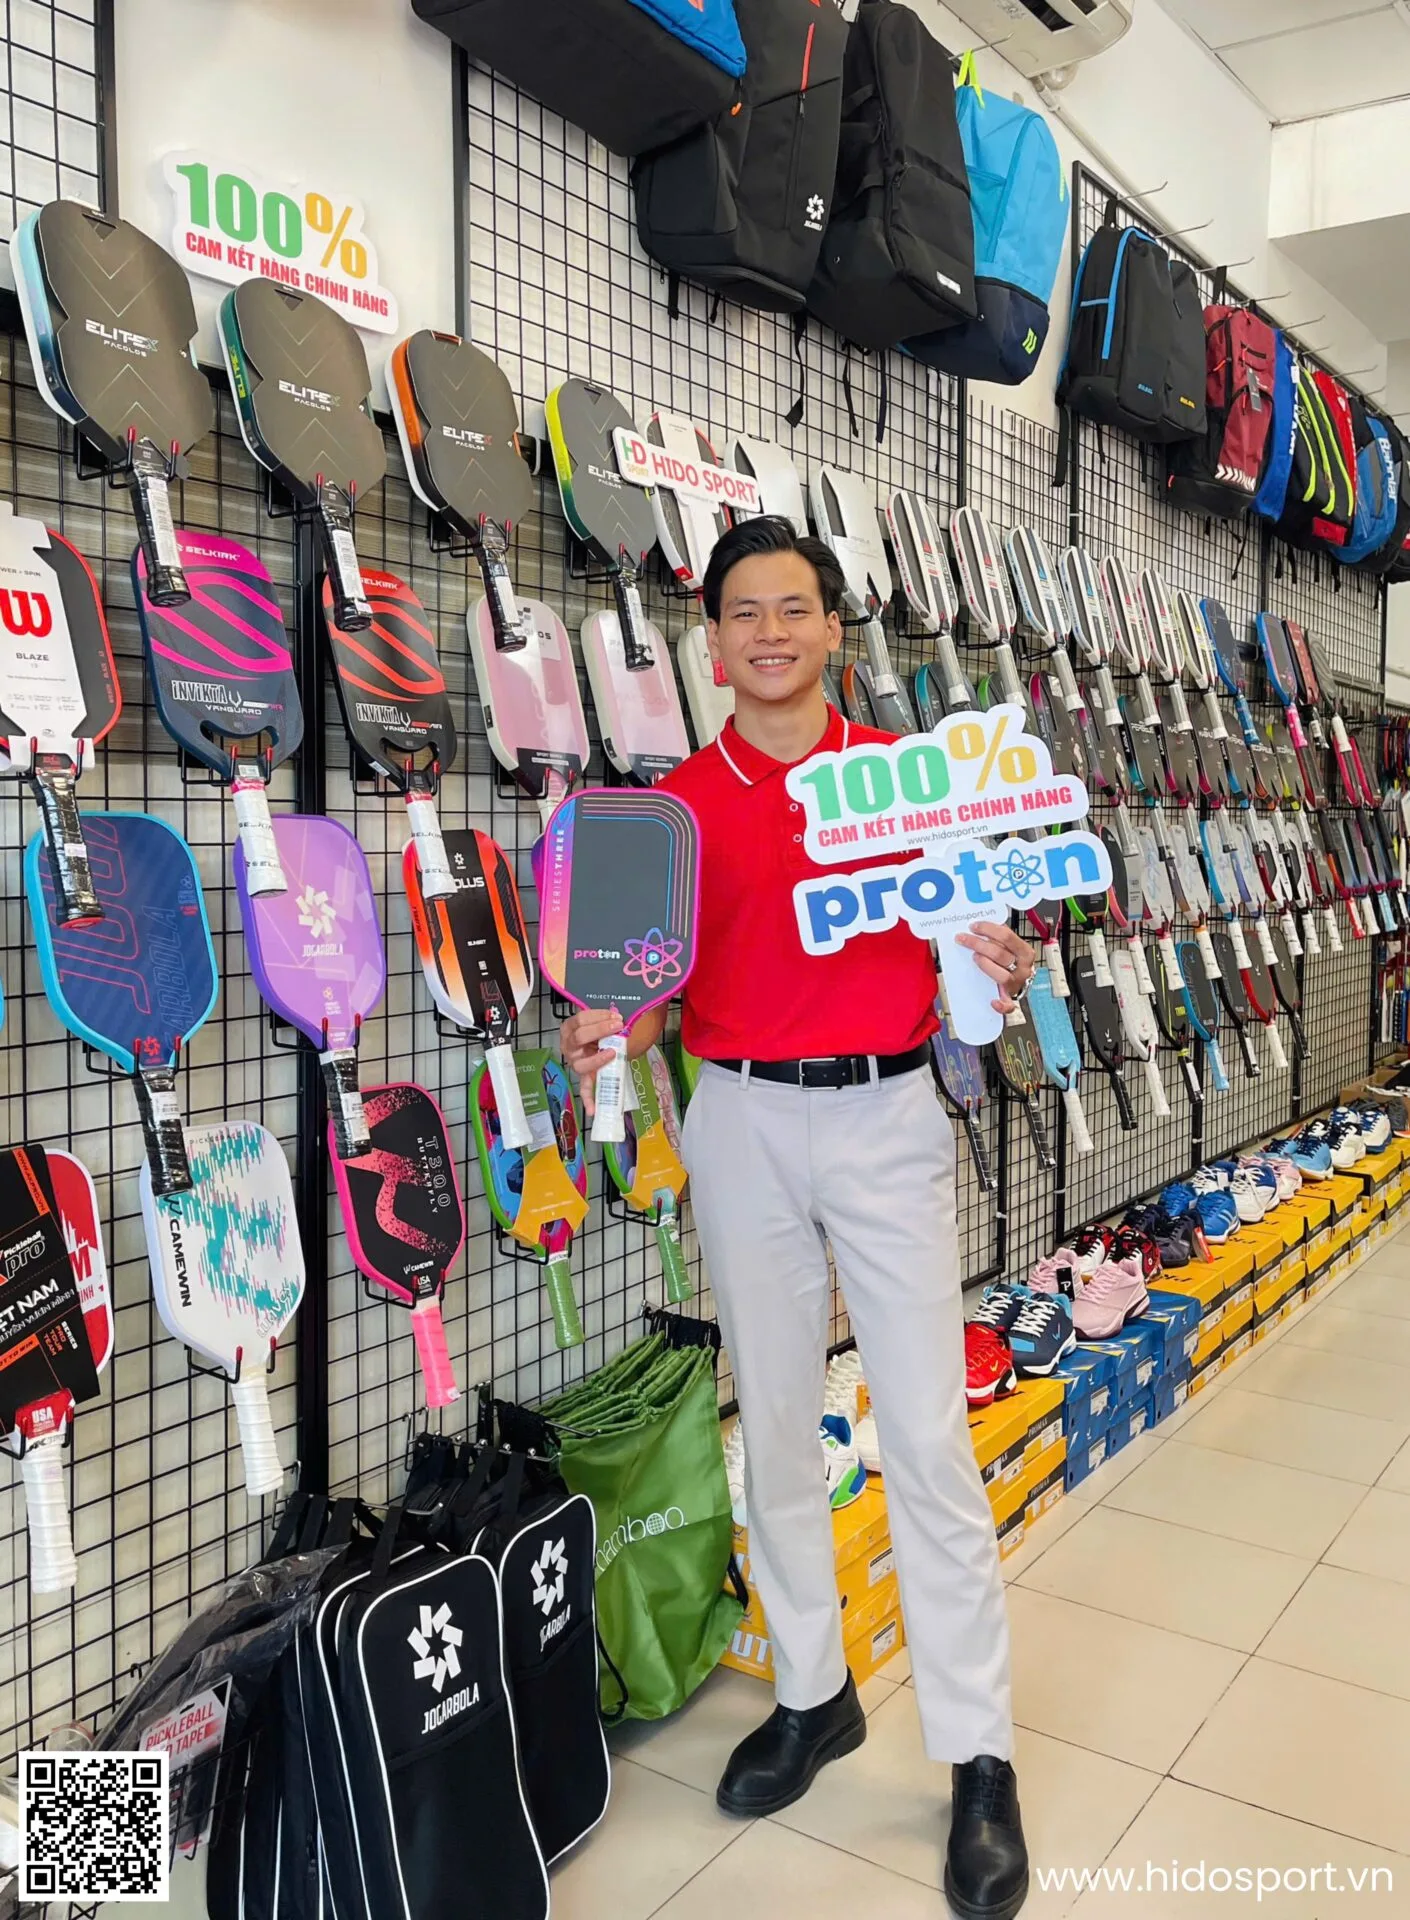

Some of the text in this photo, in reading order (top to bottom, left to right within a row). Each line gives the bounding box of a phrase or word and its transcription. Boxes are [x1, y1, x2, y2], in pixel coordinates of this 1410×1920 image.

[176, 162, 367, 279] 100%
[186, 232, 222, 261] CAM
[227, 244, 255, 272] KẾT
[260, 257, 300, 287] HÀNG
[305, 273, 348, 304] CHÍNH
[652, 453, 755, 504] HIDO SPORT
[185, 546, 238, 560] SELKIRK
[16, 652, 49, 661] BLAZE
[205, 704, 262, 715] VANGUARD
[383, 725, 427, 735] VANGUARD
[800, 714, 1037, 821] 100%
[818, 825, 858, 847] CAM
[864, 814, 895, 840] KẾT
[903, 808, 953, 832] HÀNG
[957, 796, 1016, 823] CHÍNH
[907, 824, 989, 845] www.hidosport.vn
[805, 842, 1100, 943] proton
[919, 908, 996, 928] www.hidosport.vn
[425, 1135, 451, 1208] T300
[4, 1230, 42, 1258] Pickleball
[169, 1219, 192, 1307] CAMEWIN
[418, 1274, 431, 1286] USA
[16, 1278, 59, 1314] NAM
[44, 1333, 57, 1356] TEAM
[50, 1329, 63, 1352] TOUR
[56, 1325, 67, 1342] PRO
[61, 1321, 78, 1350] SERIES
[31, 1406, 53, 1423] USA
[145, 1702, 214, 1751] PICKLEBALL
[176, 1727, 205, 1750] TAPE
